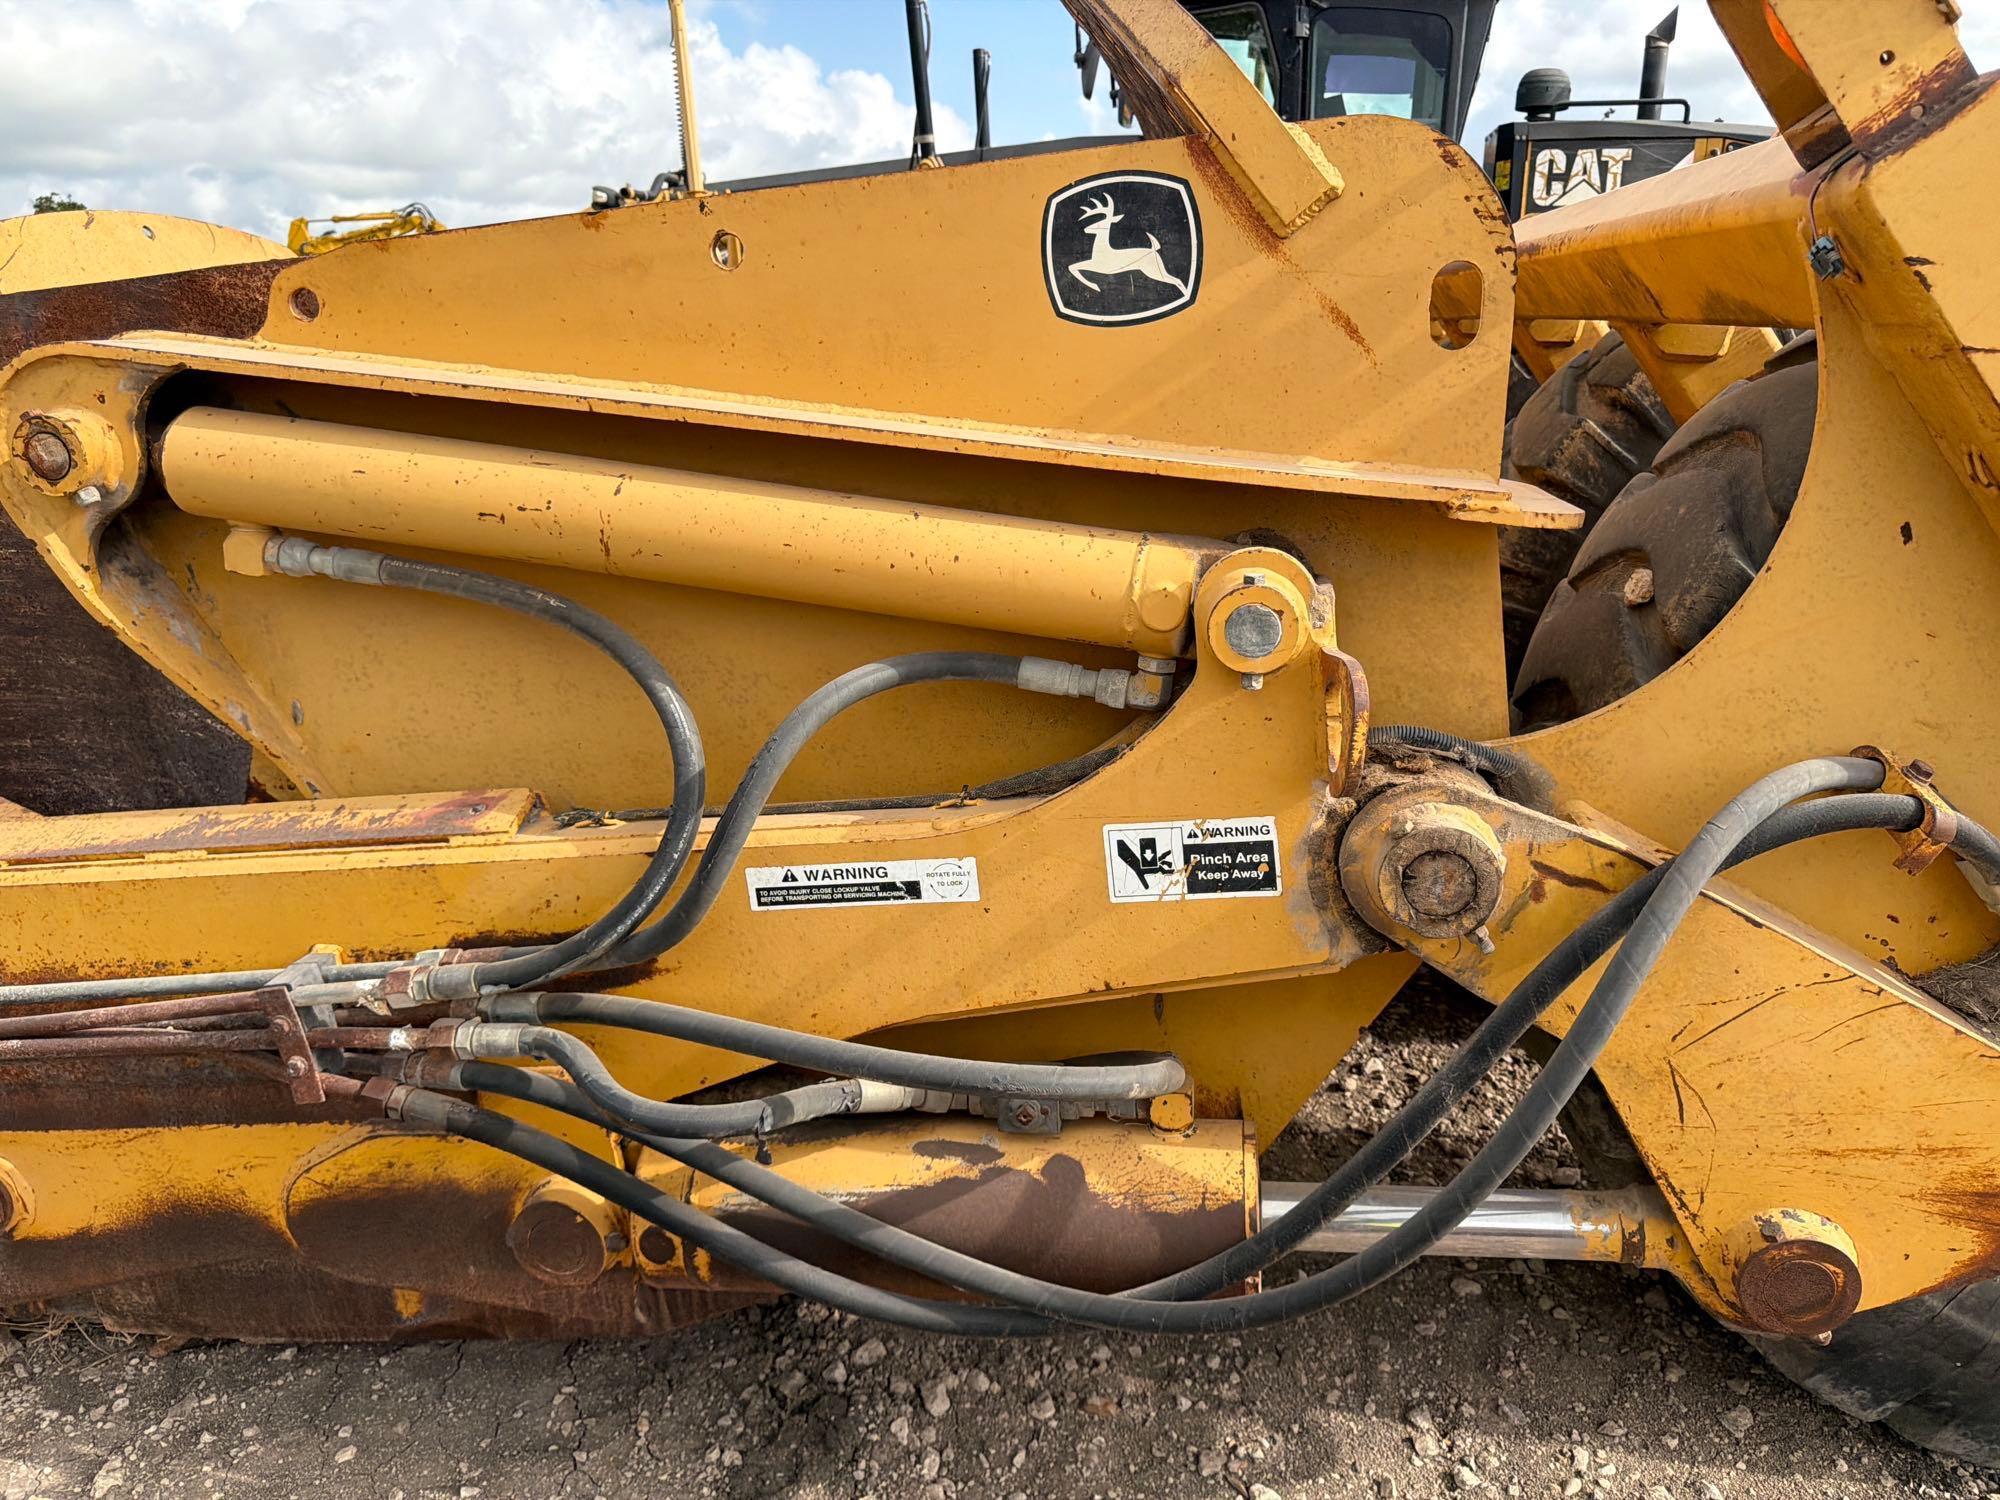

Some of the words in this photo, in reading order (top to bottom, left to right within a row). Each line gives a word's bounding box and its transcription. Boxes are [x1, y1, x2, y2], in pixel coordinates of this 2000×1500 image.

[1532, 148, 1633, 207] CAT
[1200, 825, 1271, 838] WARNING
[1190, 852, 1232, 865] Pinch
[1236, 852, 1269, 864] Area
[803, 867, 889, 882] WARNING
[1198, 870, 1229, 881] Keep
[1232, 869, 1264, 880] Away
